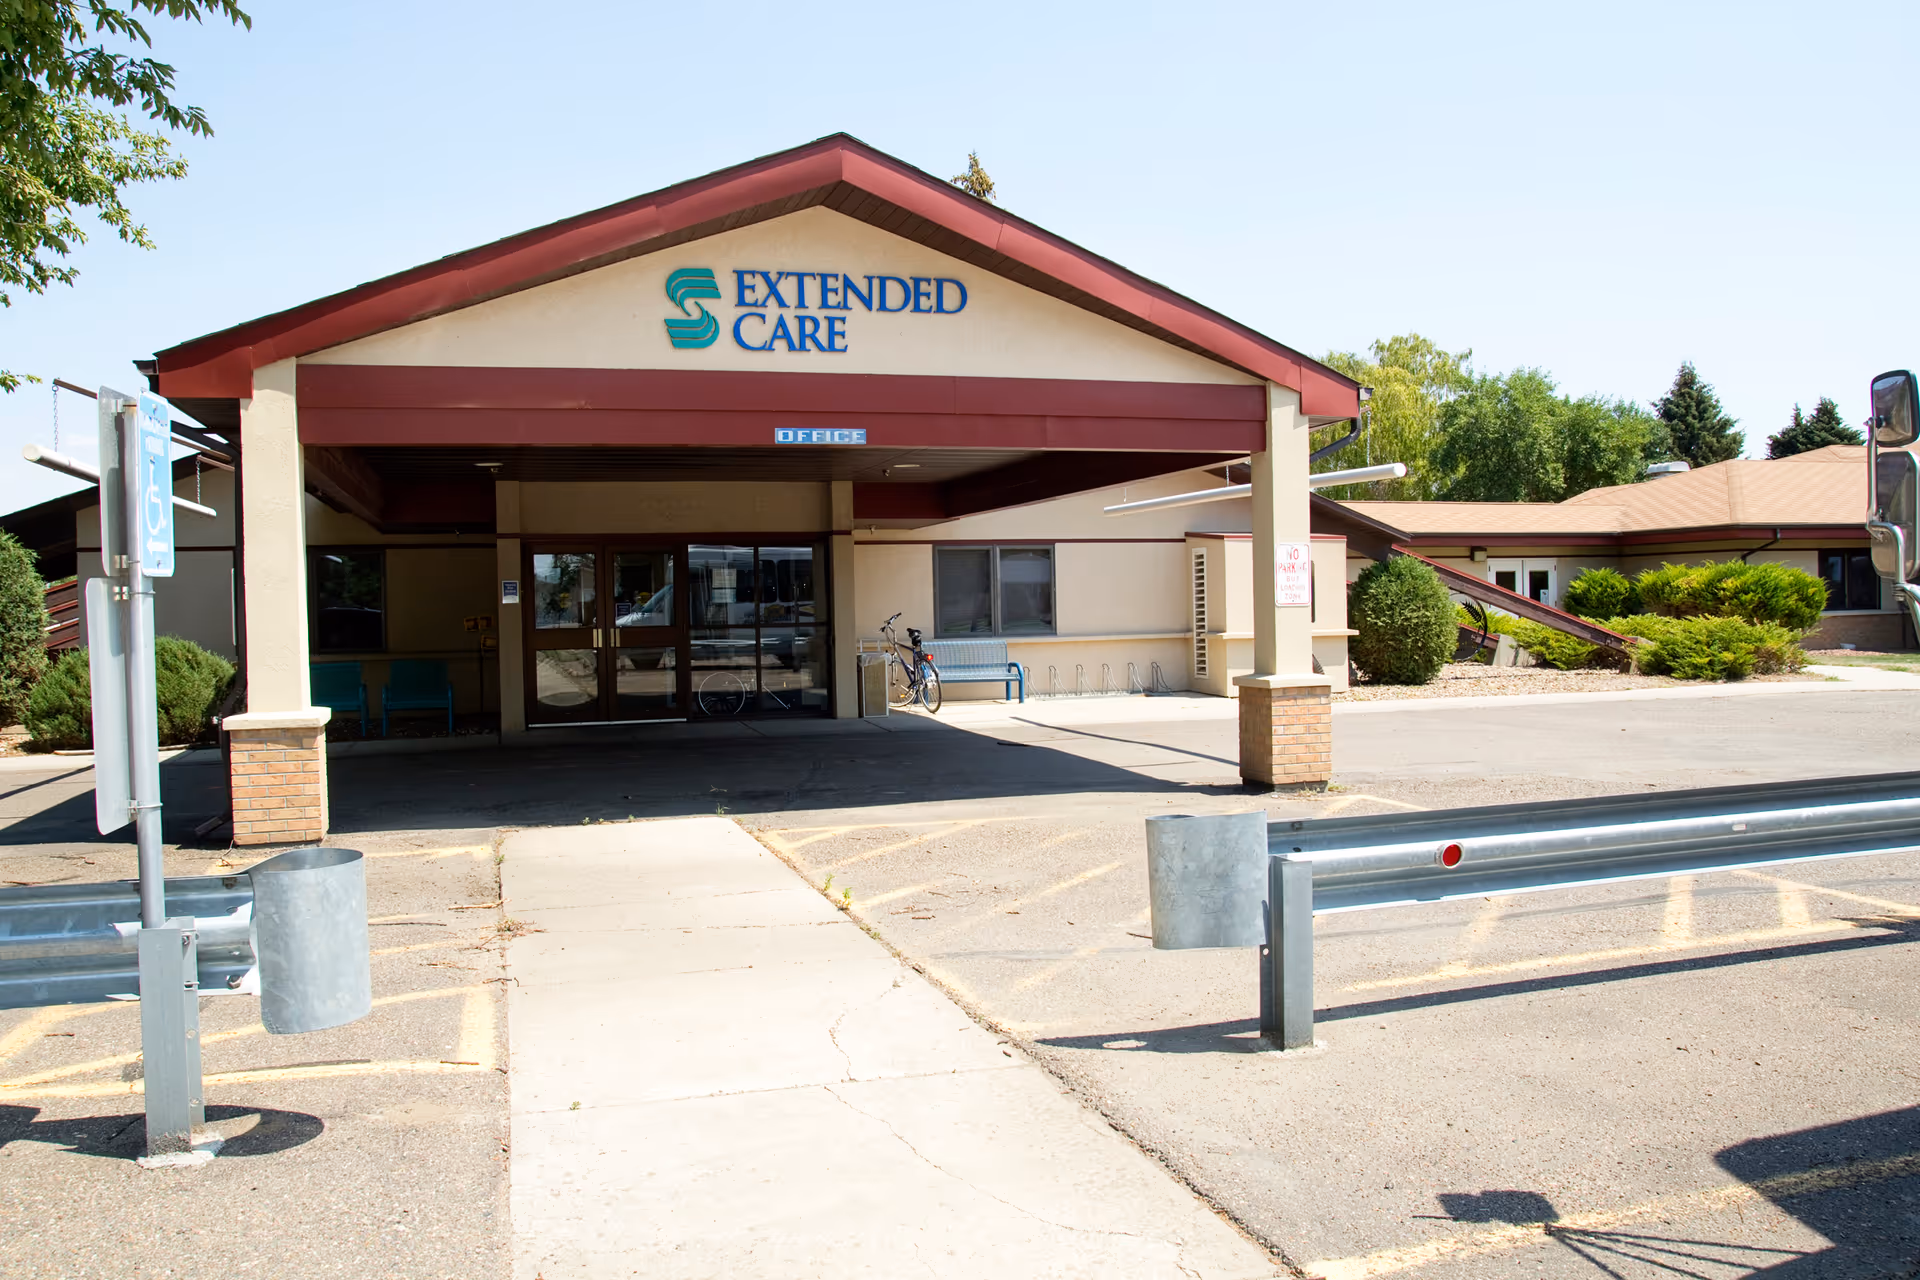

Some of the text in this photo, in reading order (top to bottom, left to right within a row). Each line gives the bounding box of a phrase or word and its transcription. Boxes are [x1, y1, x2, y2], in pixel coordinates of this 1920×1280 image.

[732, 269, 968, 314] EXTENDED
[732, 312, 848, 352] CARE
[777, 430, 864, 443] OFFICE
[1286, 547, 1299, 560] NO
[1279, 562, 1307, 574] PARKG
[1280, 584, 1305, 592] LOAD
